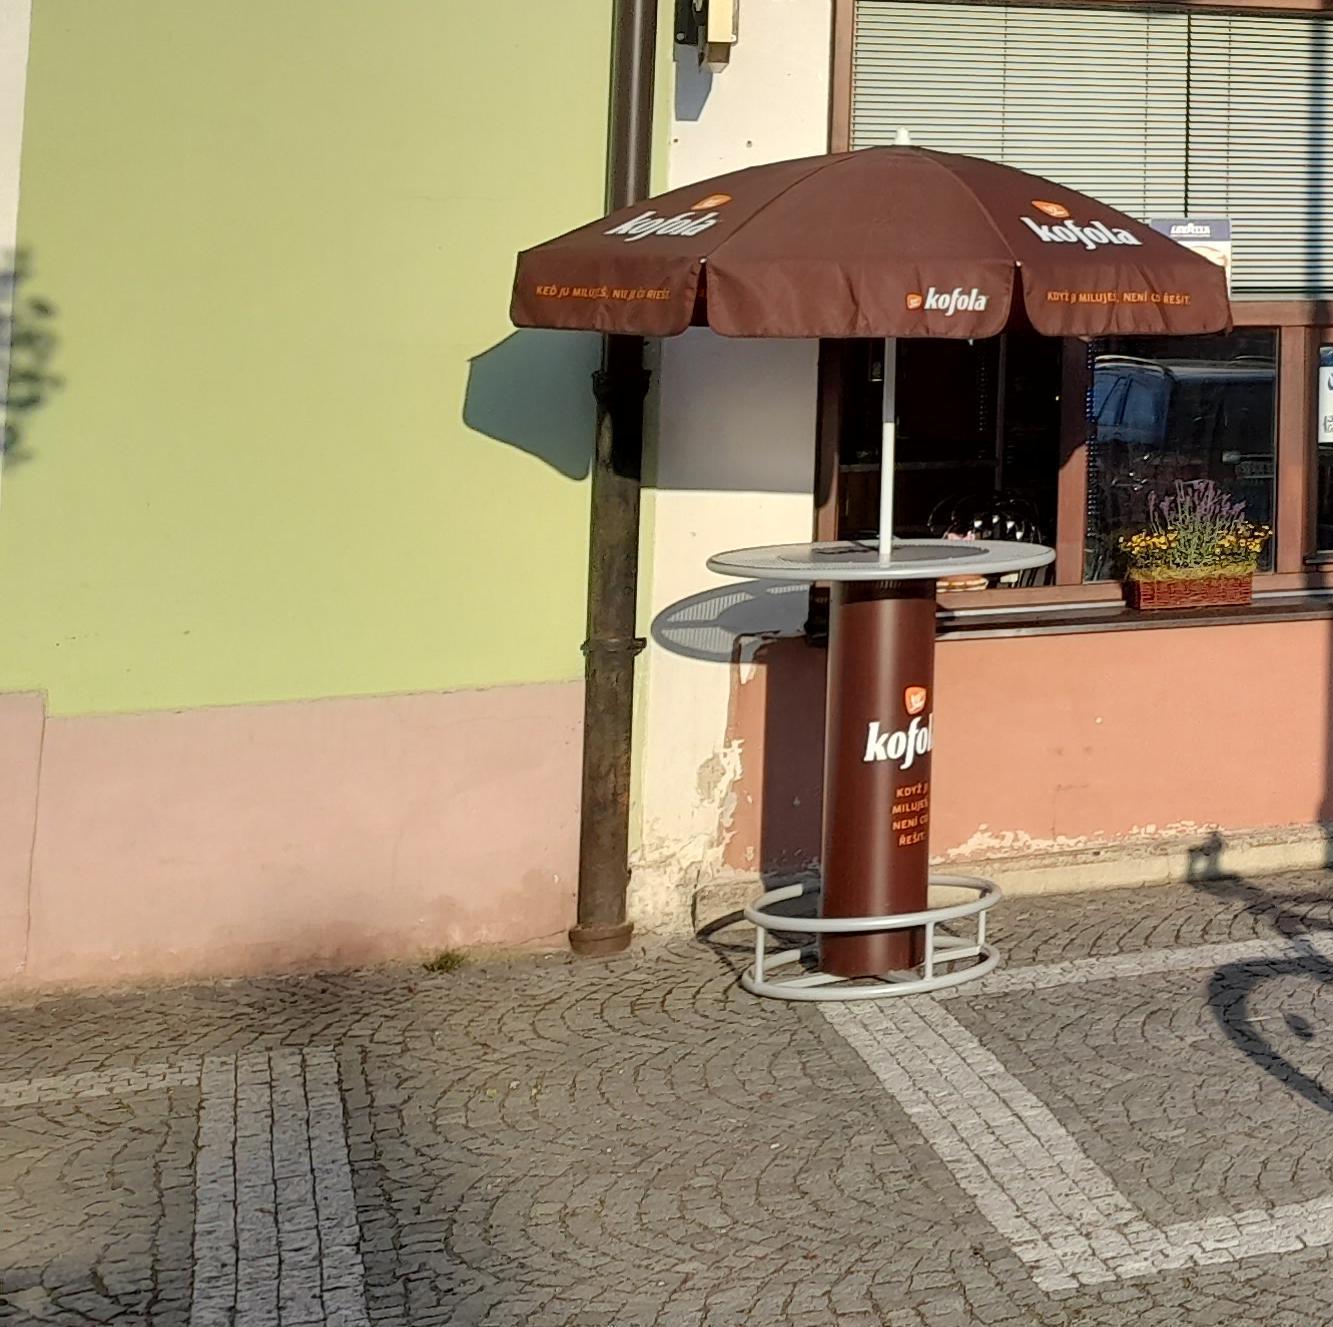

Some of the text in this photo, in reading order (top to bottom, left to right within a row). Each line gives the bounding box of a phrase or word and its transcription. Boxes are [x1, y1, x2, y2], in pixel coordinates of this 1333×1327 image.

[604, 210, 720, 242] kofola
[1020, 216, 1143, 250] kofola
[924, 287, 988, 316] kofola
[1123, 290, 1148, 303] NENÍ
[864, 713, 934, 769] kofol
